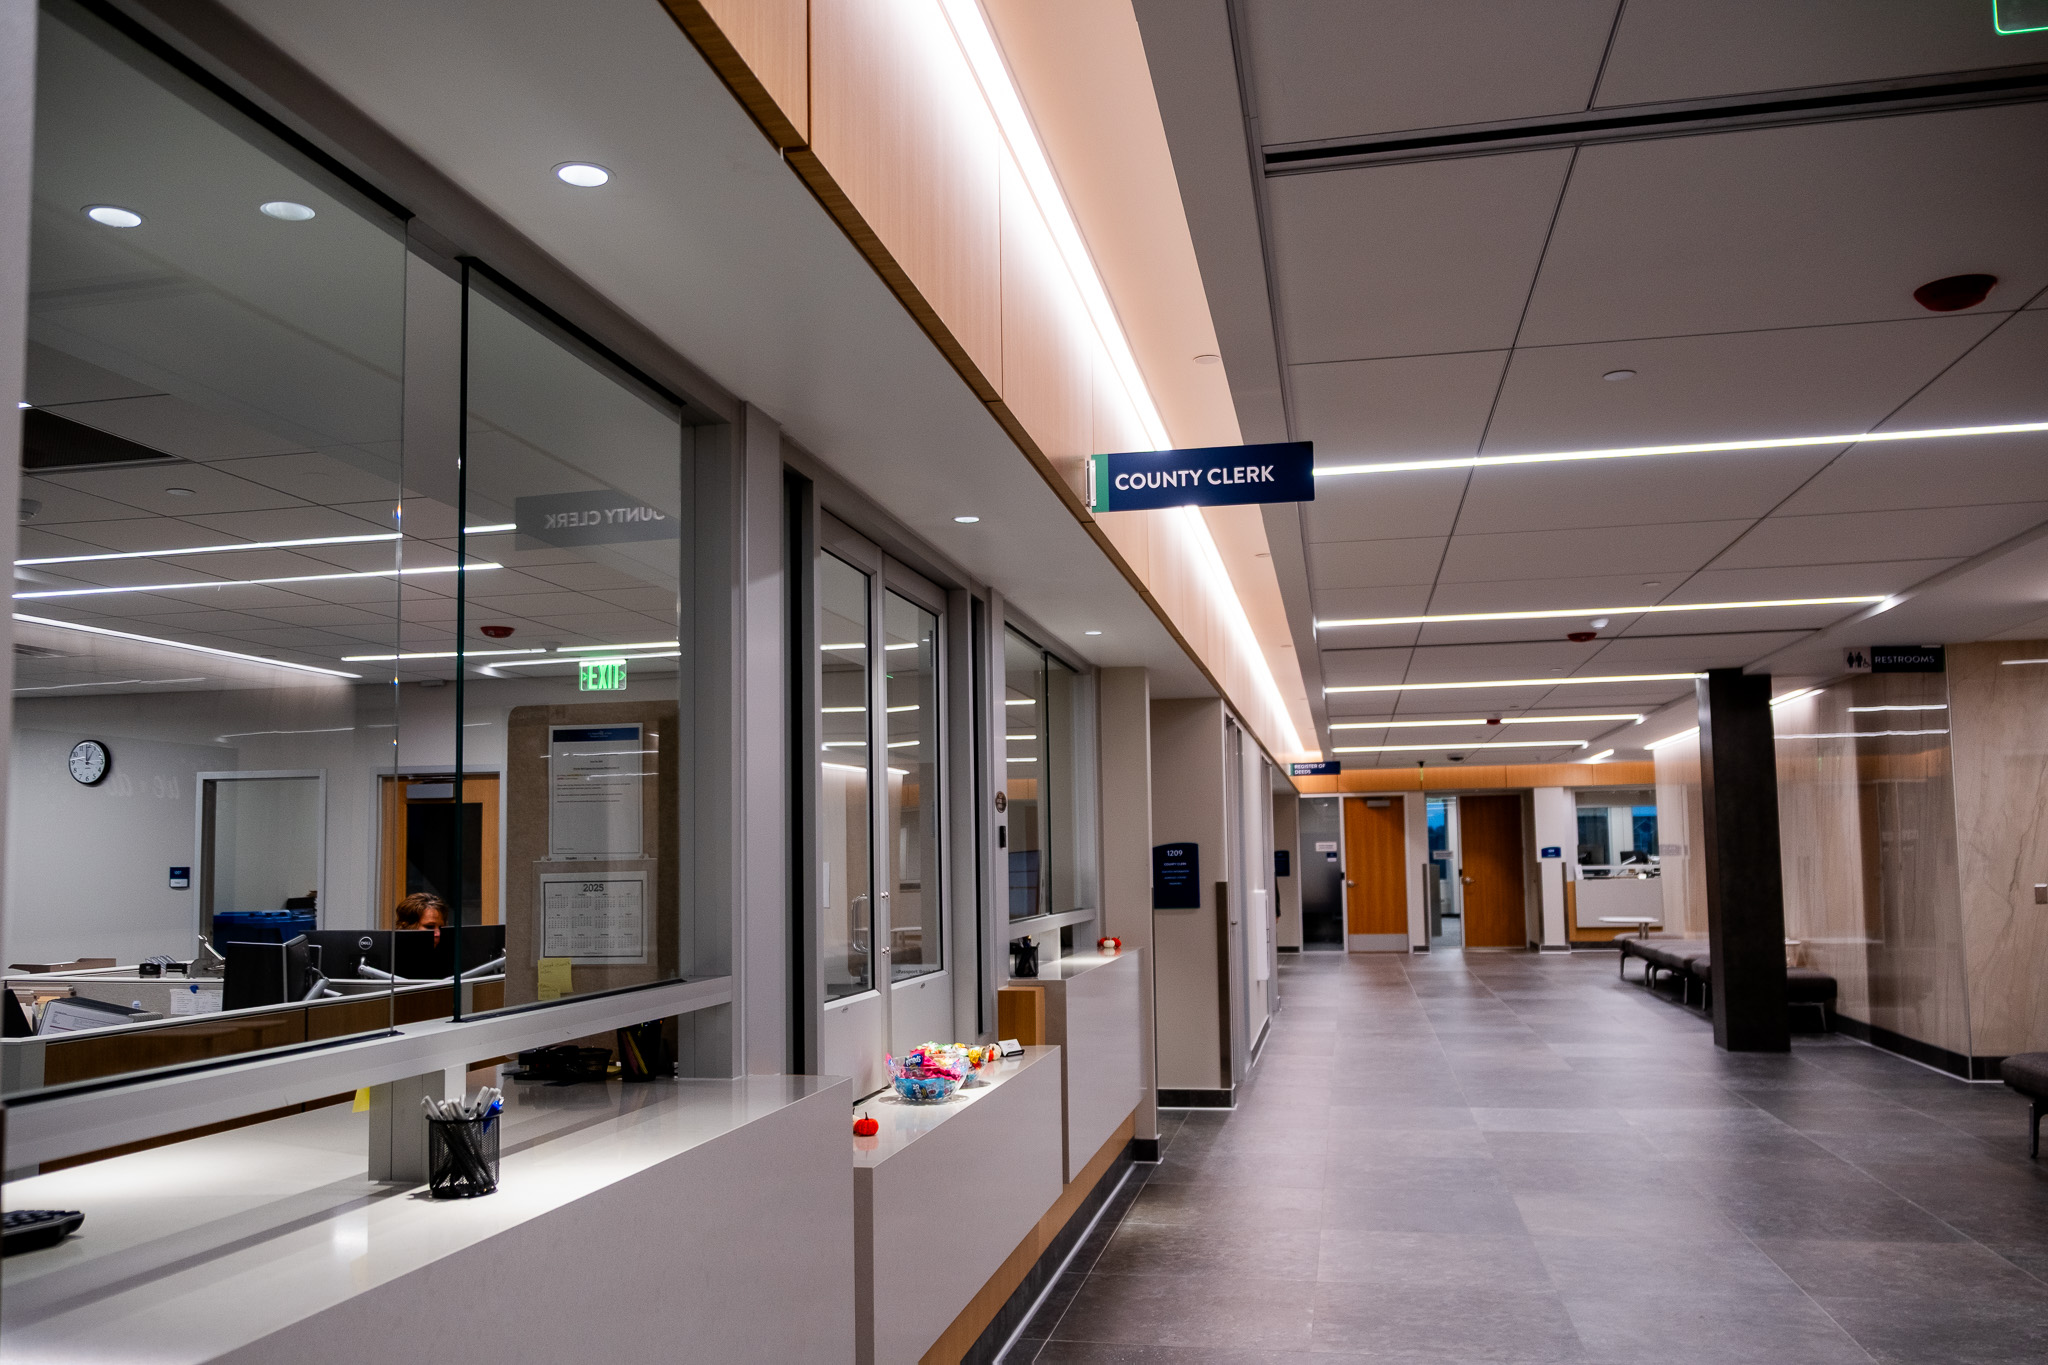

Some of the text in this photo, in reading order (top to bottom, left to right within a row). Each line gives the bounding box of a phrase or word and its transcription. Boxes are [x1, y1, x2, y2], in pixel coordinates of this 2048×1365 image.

[1115, 465, 1275, 491] COUNTY CLERK
[1874, 655, 1935, 664] RESTROOMS
[587, 664, 620, 690] EXIT
[583, 883, 604, 892] 2025
